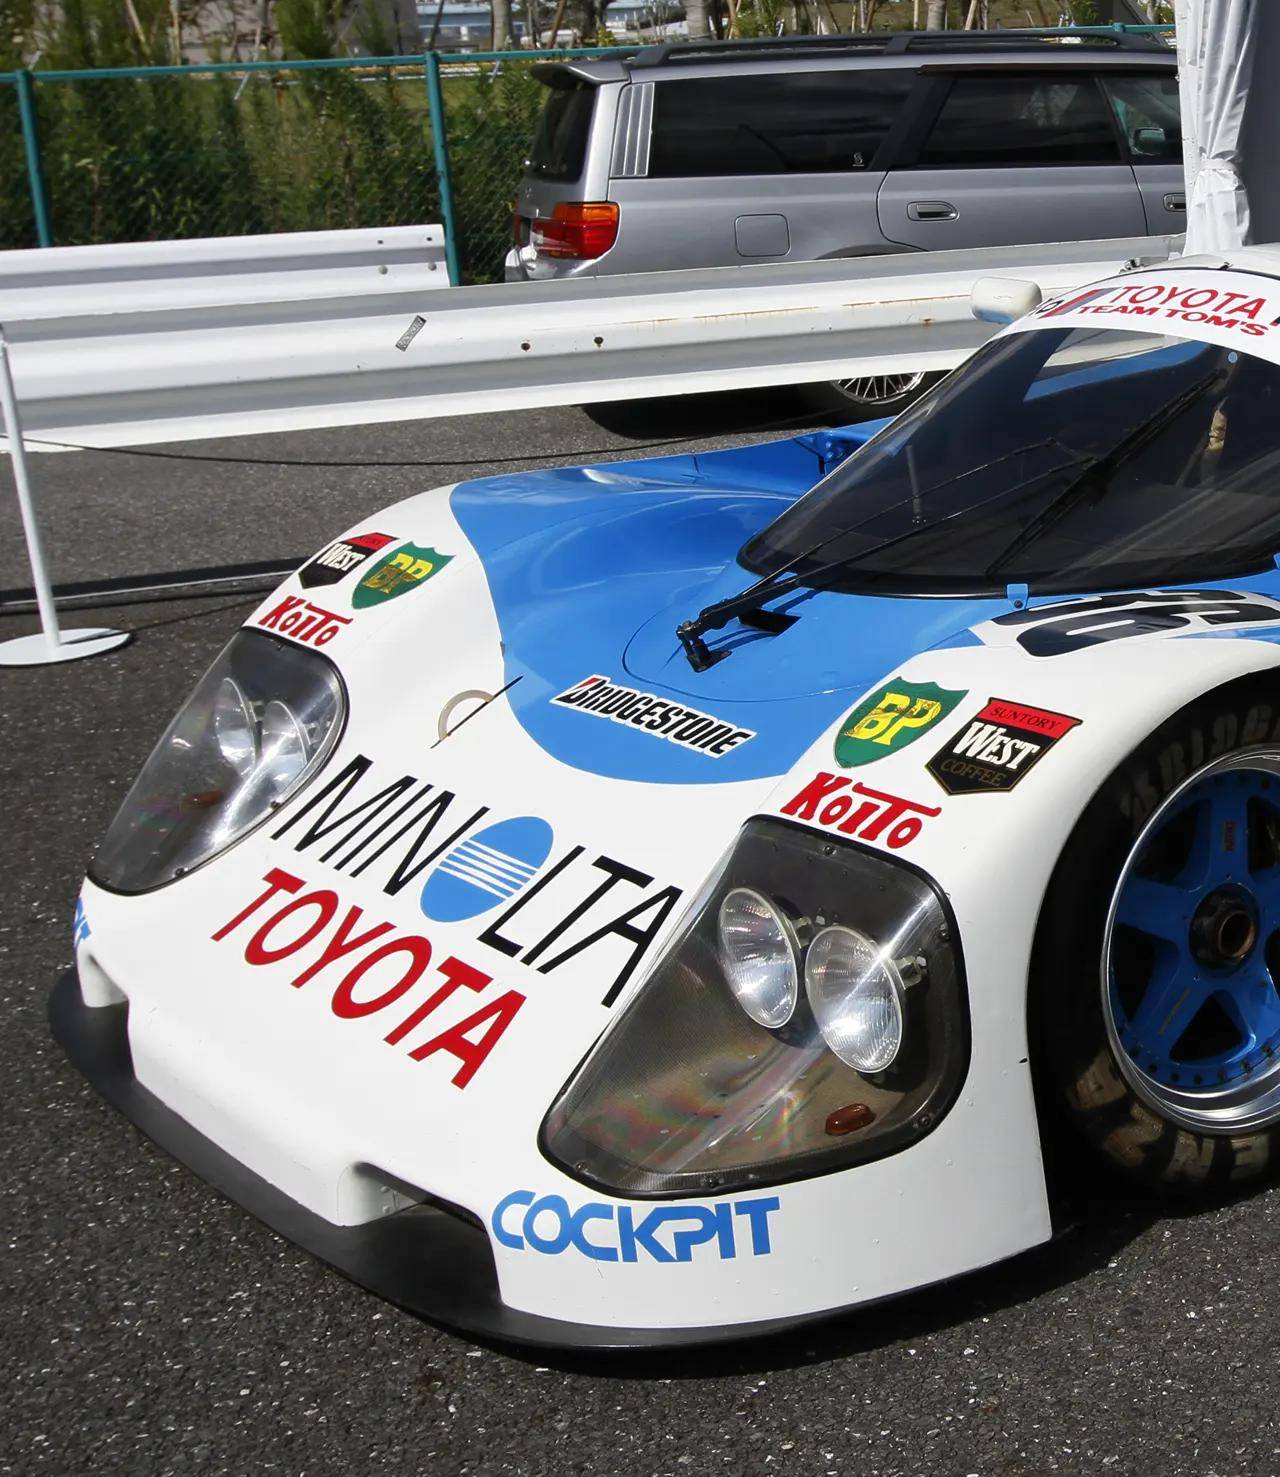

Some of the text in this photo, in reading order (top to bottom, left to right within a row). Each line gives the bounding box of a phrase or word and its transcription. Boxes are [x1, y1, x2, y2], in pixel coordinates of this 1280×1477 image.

[1078, 306, 1161, 315] TEAM
[1166, 308, 1268, 336] TOM'S
[1109, 286, 1267, 319] TOYOTA
[316, 542, 366, 571] WEST
[362, 553, 433, 594] BP
[553, 677, 752, 755] BRIDGESTONE
[843, 692, 942, 746] BP
[991, 707, 1061, 732] SUNTORY
[953, 721, 1041, 770] WEST
[940, 758, 1008, 786] COFFEE
[270, 754, 684, 1009] MINOLTA
[211, 867, 527, 1090] TOYOTA
[491, 1189, 781, 1263] COCKPIT
